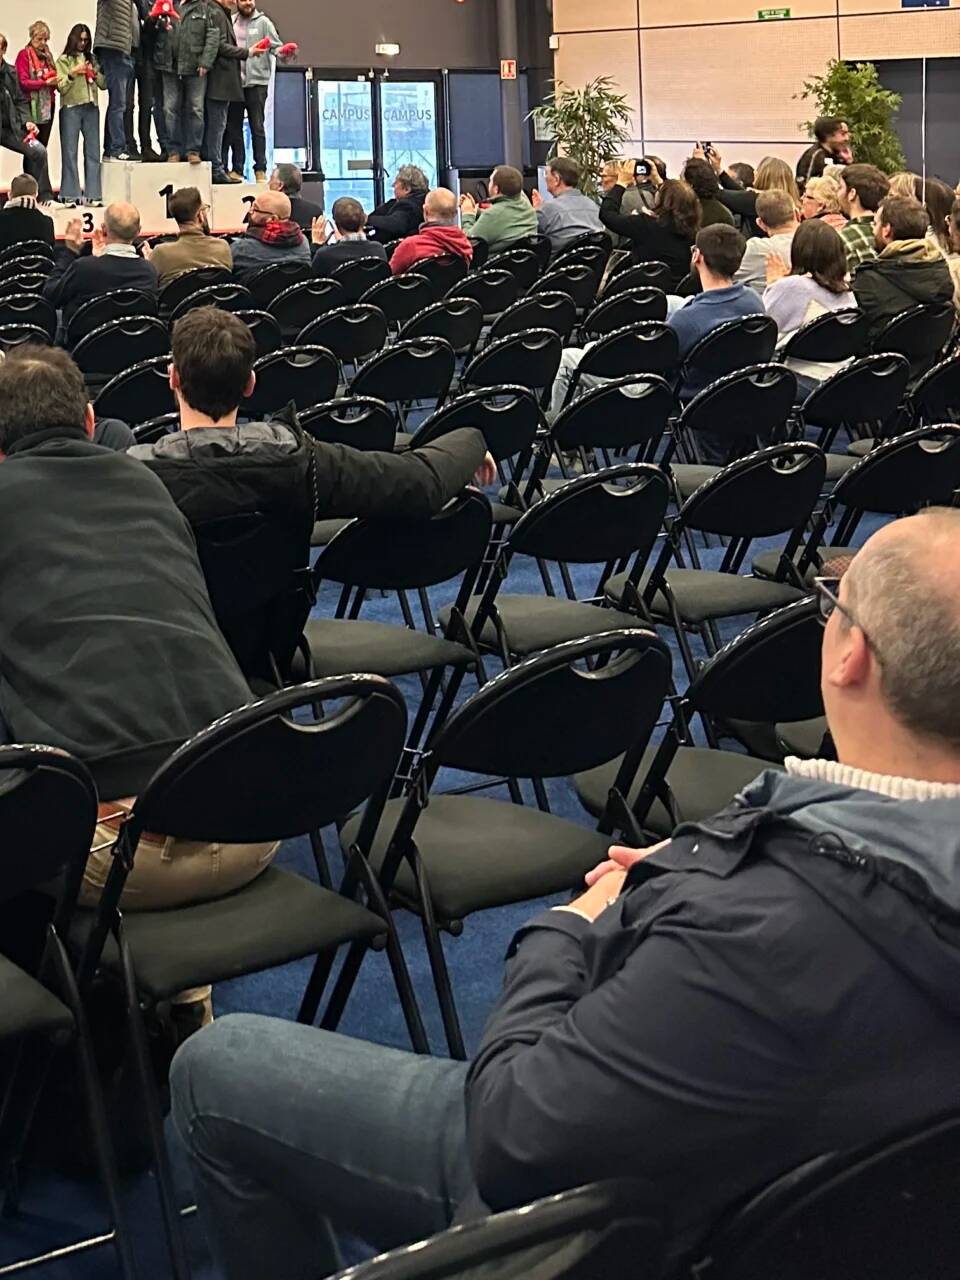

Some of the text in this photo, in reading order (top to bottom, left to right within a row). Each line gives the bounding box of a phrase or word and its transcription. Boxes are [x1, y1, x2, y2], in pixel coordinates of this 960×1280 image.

[322, 108, 370, 121] CAMPUS
[383, 108, 432, 121] CAMPUS
[158, 184, 174, 219] 1
[82, 212, 95, 233] 3
